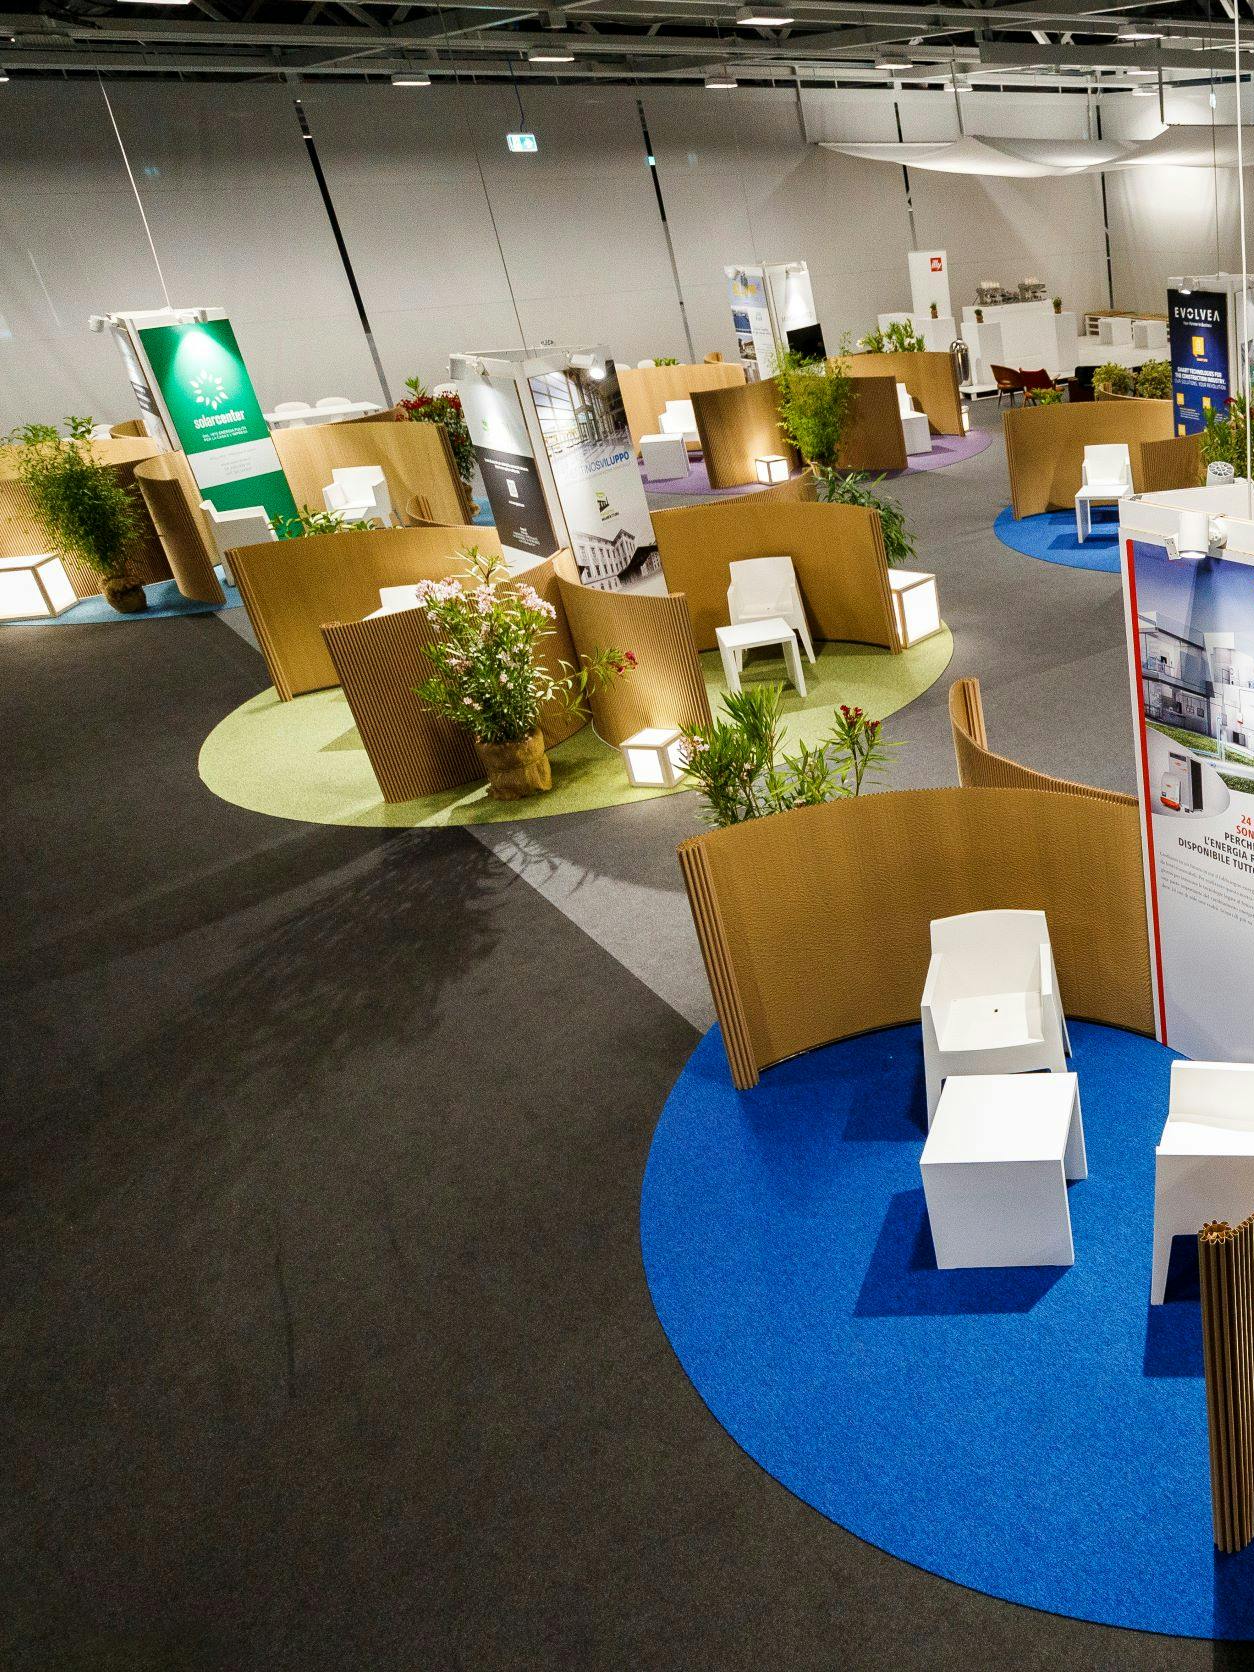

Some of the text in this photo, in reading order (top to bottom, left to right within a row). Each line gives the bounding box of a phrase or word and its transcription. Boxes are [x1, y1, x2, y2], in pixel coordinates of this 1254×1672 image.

[1174, 306, 1220, 322] EVOLVEA
[193, 409, 245, 429] solarcenter
[1240, 814, 1252, 826] 24
[1178, 837, 1231, 866] DISPONIBILE
[1204, 836, 1248, 860] L'ENERGIA
